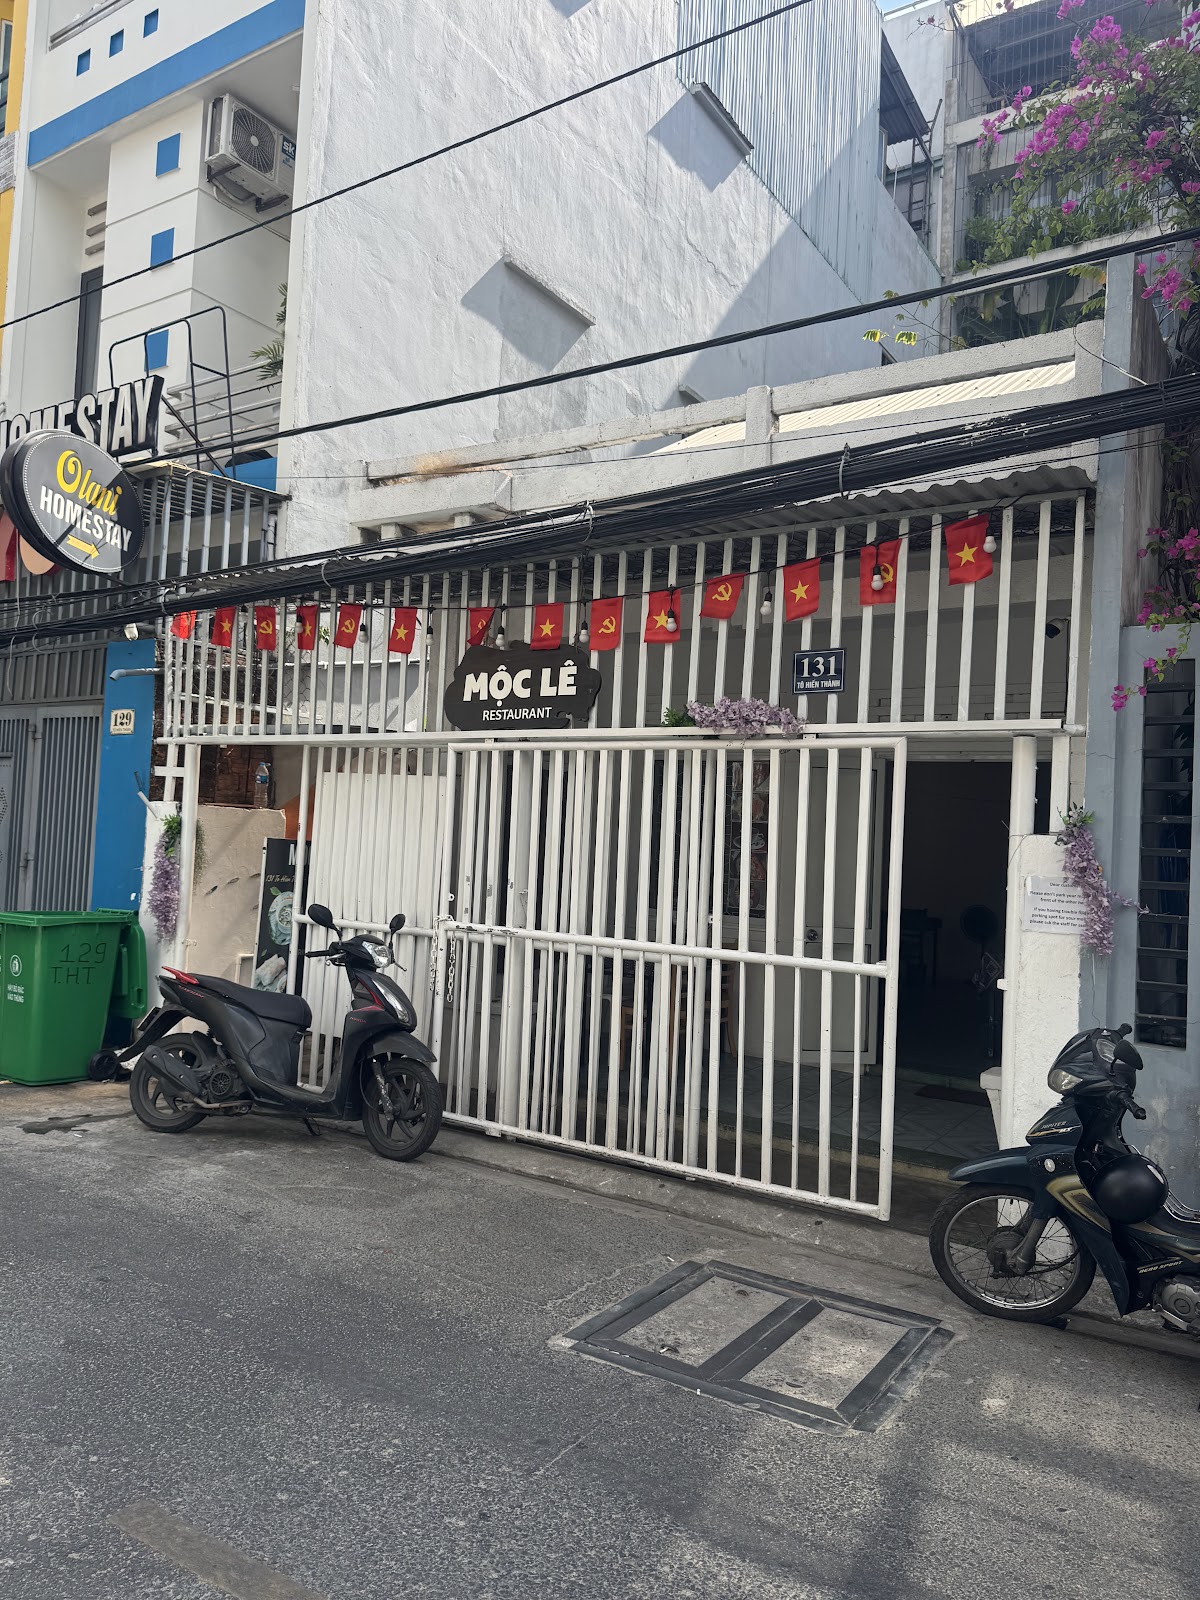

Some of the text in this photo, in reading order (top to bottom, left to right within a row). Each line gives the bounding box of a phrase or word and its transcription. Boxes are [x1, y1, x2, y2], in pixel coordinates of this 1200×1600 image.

[0, 376, 156, 450] STAY
[40, 485, 132, 552] HOMESTAY
[800, 656, 837, 678] 131
[463, 659, 578, 706] MỘC LÊ
[821, 679, 840, 688] THÀNH
[113, 712, 132, 726] 129
[482, 706, 552, 720] RESTAURANT
[60, 942, 107, 964] 129
